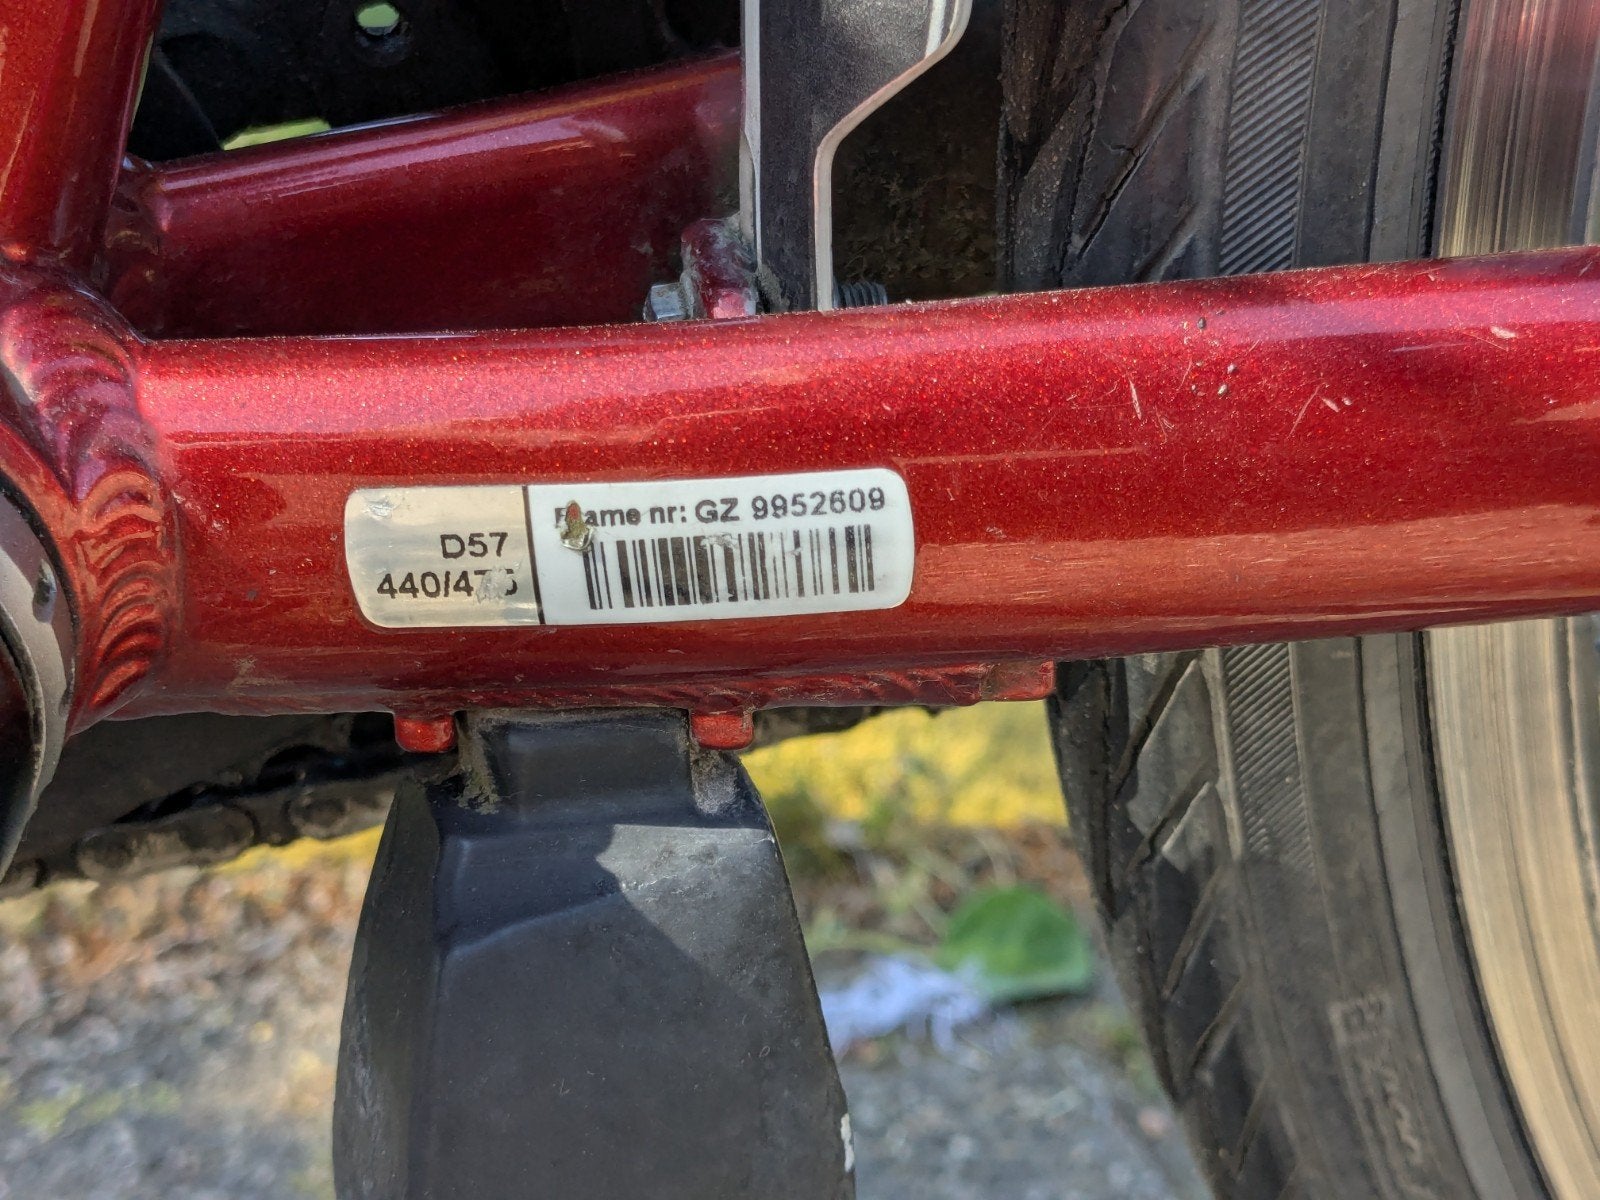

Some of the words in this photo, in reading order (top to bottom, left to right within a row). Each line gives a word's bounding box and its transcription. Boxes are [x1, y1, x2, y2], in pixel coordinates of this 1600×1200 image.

[554, 507, 641, 529] Fame
[649, 505, 688, 525] nr:
[694, 497, 741, 524] GZ
[750, 486, 886, 521] 9952609
[439, 531, 509, 560] D57
[376, 568, 518, 600] 440/4
